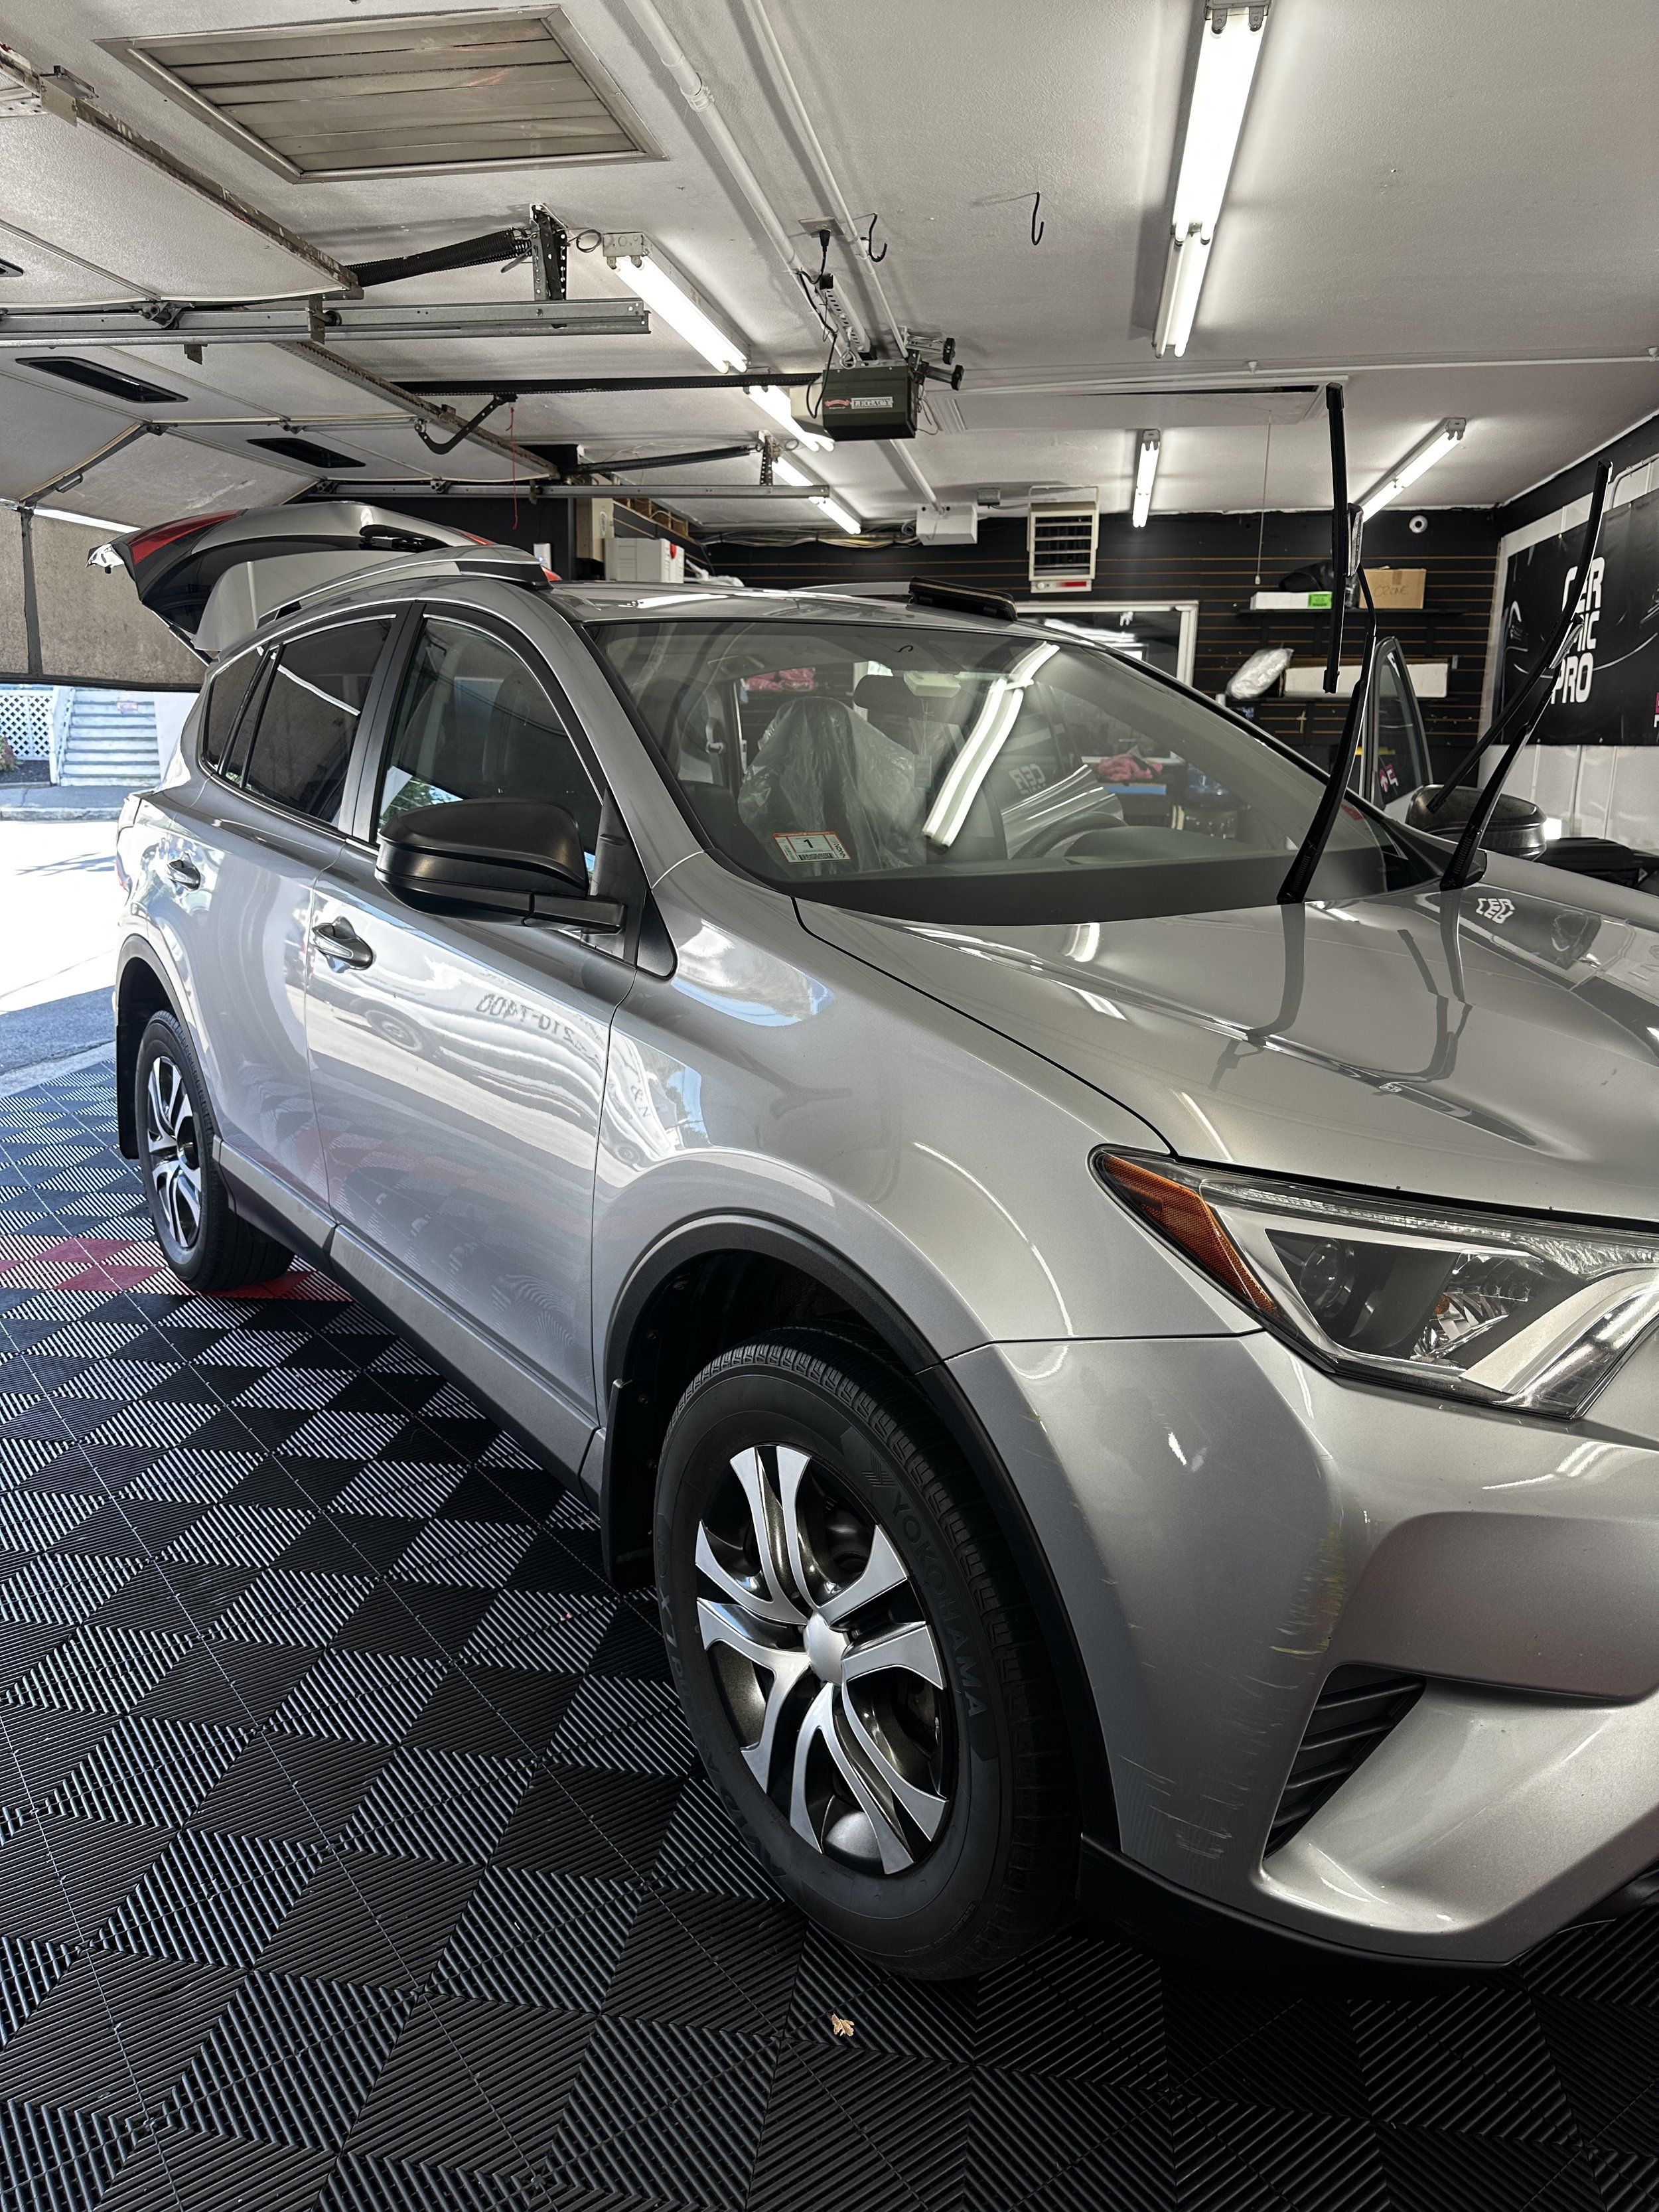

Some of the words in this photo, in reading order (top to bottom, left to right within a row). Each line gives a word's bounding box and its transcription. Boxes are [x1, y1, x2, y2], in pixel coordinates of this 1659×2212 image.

[1550, 652, 1594, 704] PRO
[804, 838, 814, 848] 1
[893, 1491, 987, 1717] YOKOHAMA
